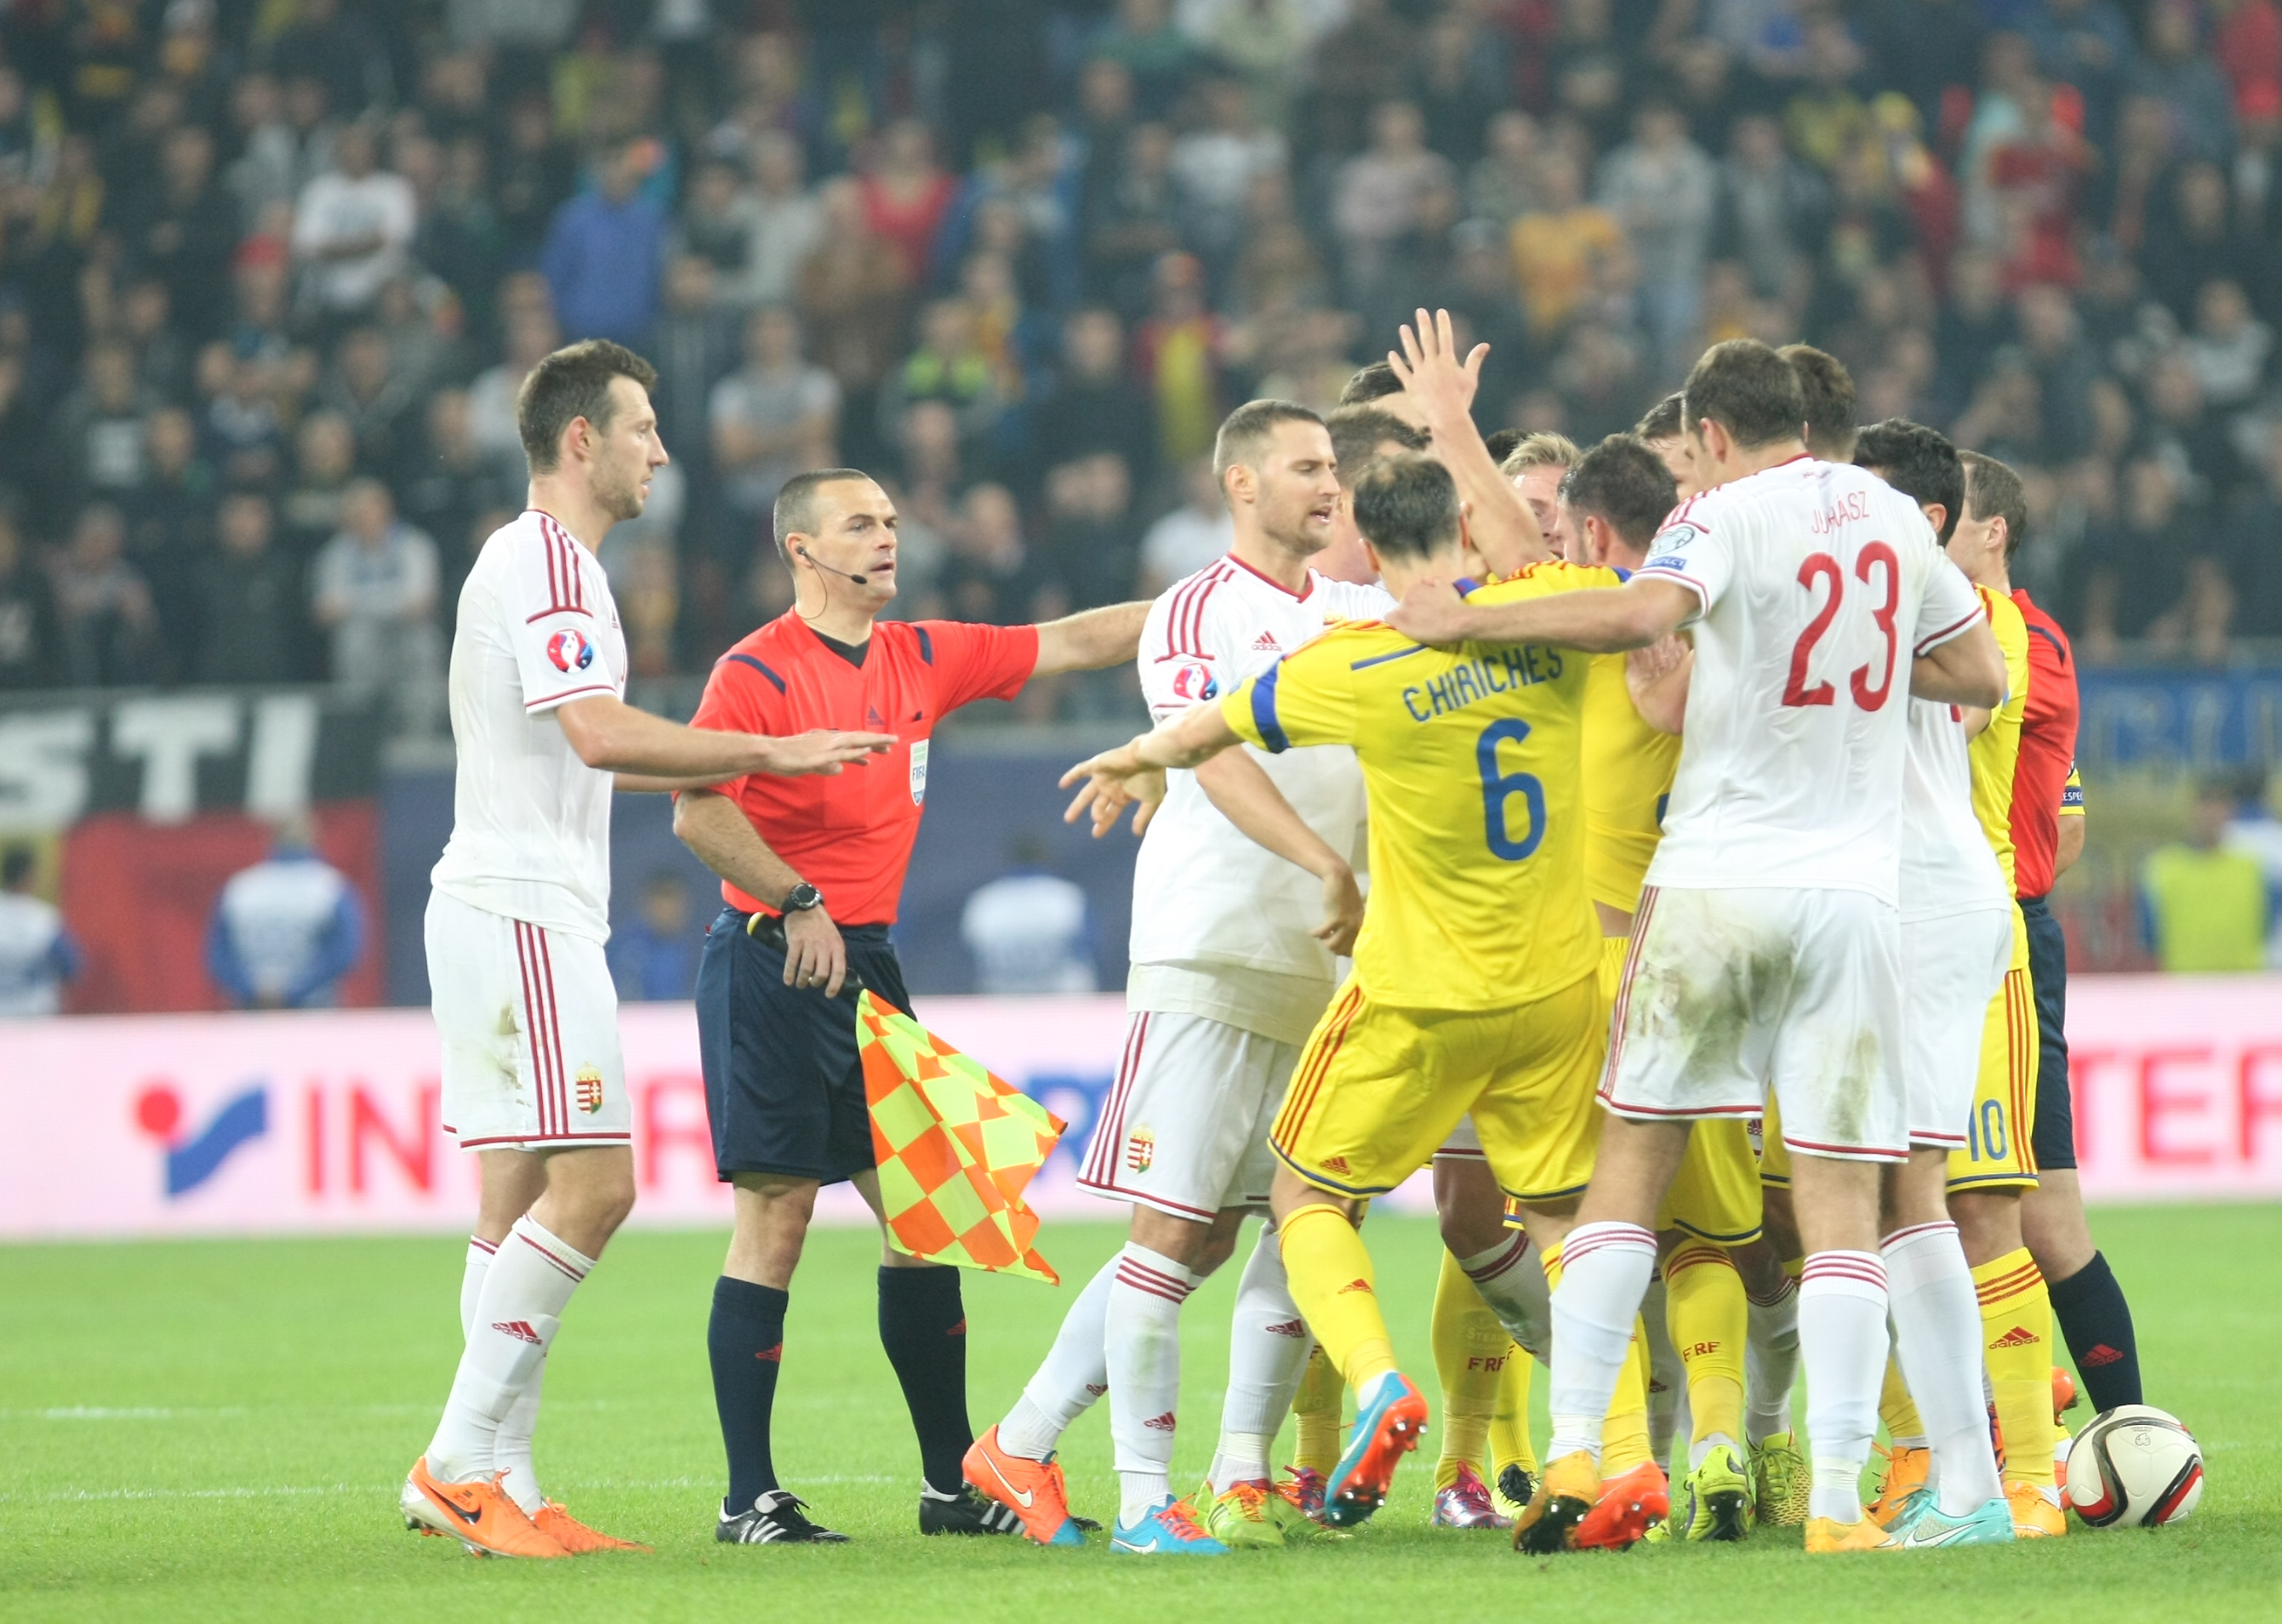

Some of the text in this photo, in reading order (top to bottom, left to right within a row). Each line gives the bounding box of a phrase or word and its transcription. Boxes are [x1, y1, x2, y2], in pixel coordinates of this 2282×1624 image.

[1781, 539, 1901, 713] 23
[1402, 644, 1564, 722] CHIRICHES
[1476, 716, 1548, 861] 6
[1968, 1098, 2008, 1162] 10
[1682, 1341, 1720, 1362] FRF
[1988, 1336, 2040, 1350] adidas
